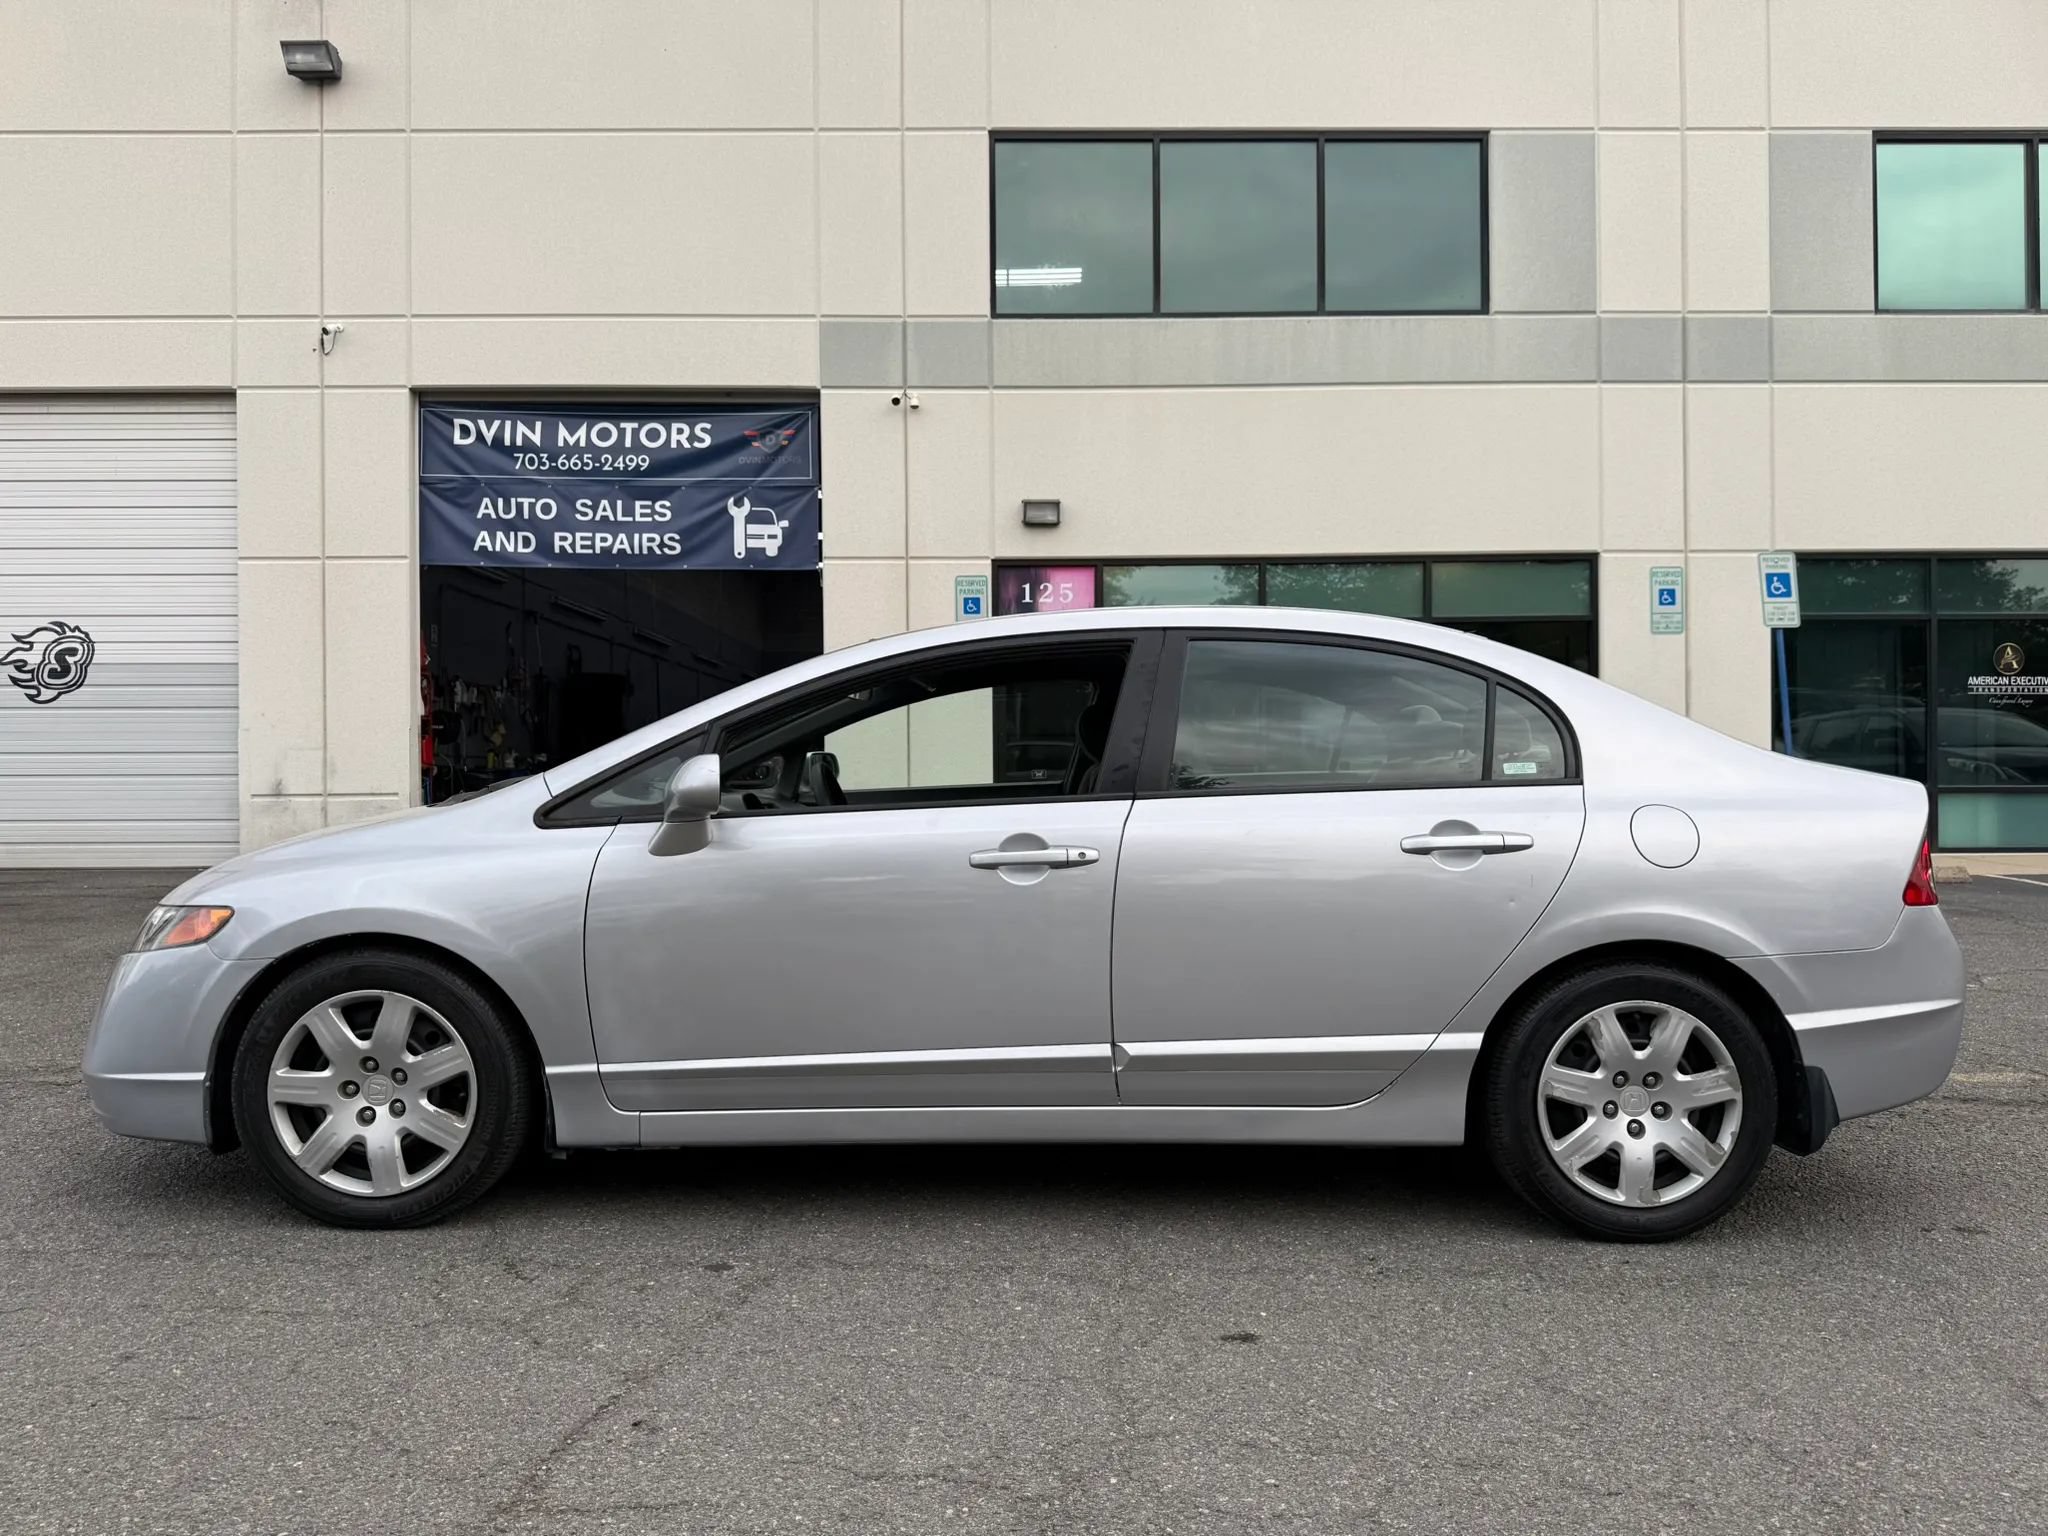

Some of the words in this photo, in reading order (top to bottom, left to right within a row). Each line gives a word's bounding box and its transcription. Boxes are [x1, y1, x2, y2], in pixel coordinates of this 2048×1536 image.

[453, 418, 542, 448] DVIN
[557, 421, 713, 449] MOTORS
[513, 453, 650, 472] 703-665-2499
[476, 497, 557, 521] AUTO
[574, 499, 673, 522] SALES
[473, 530, 537, 554] AND
[553, 532, 683, 556] REPAIRS
[1021, 583, 1074, 603] 125
[1967, 676, 2009, 685] AMERICAN
